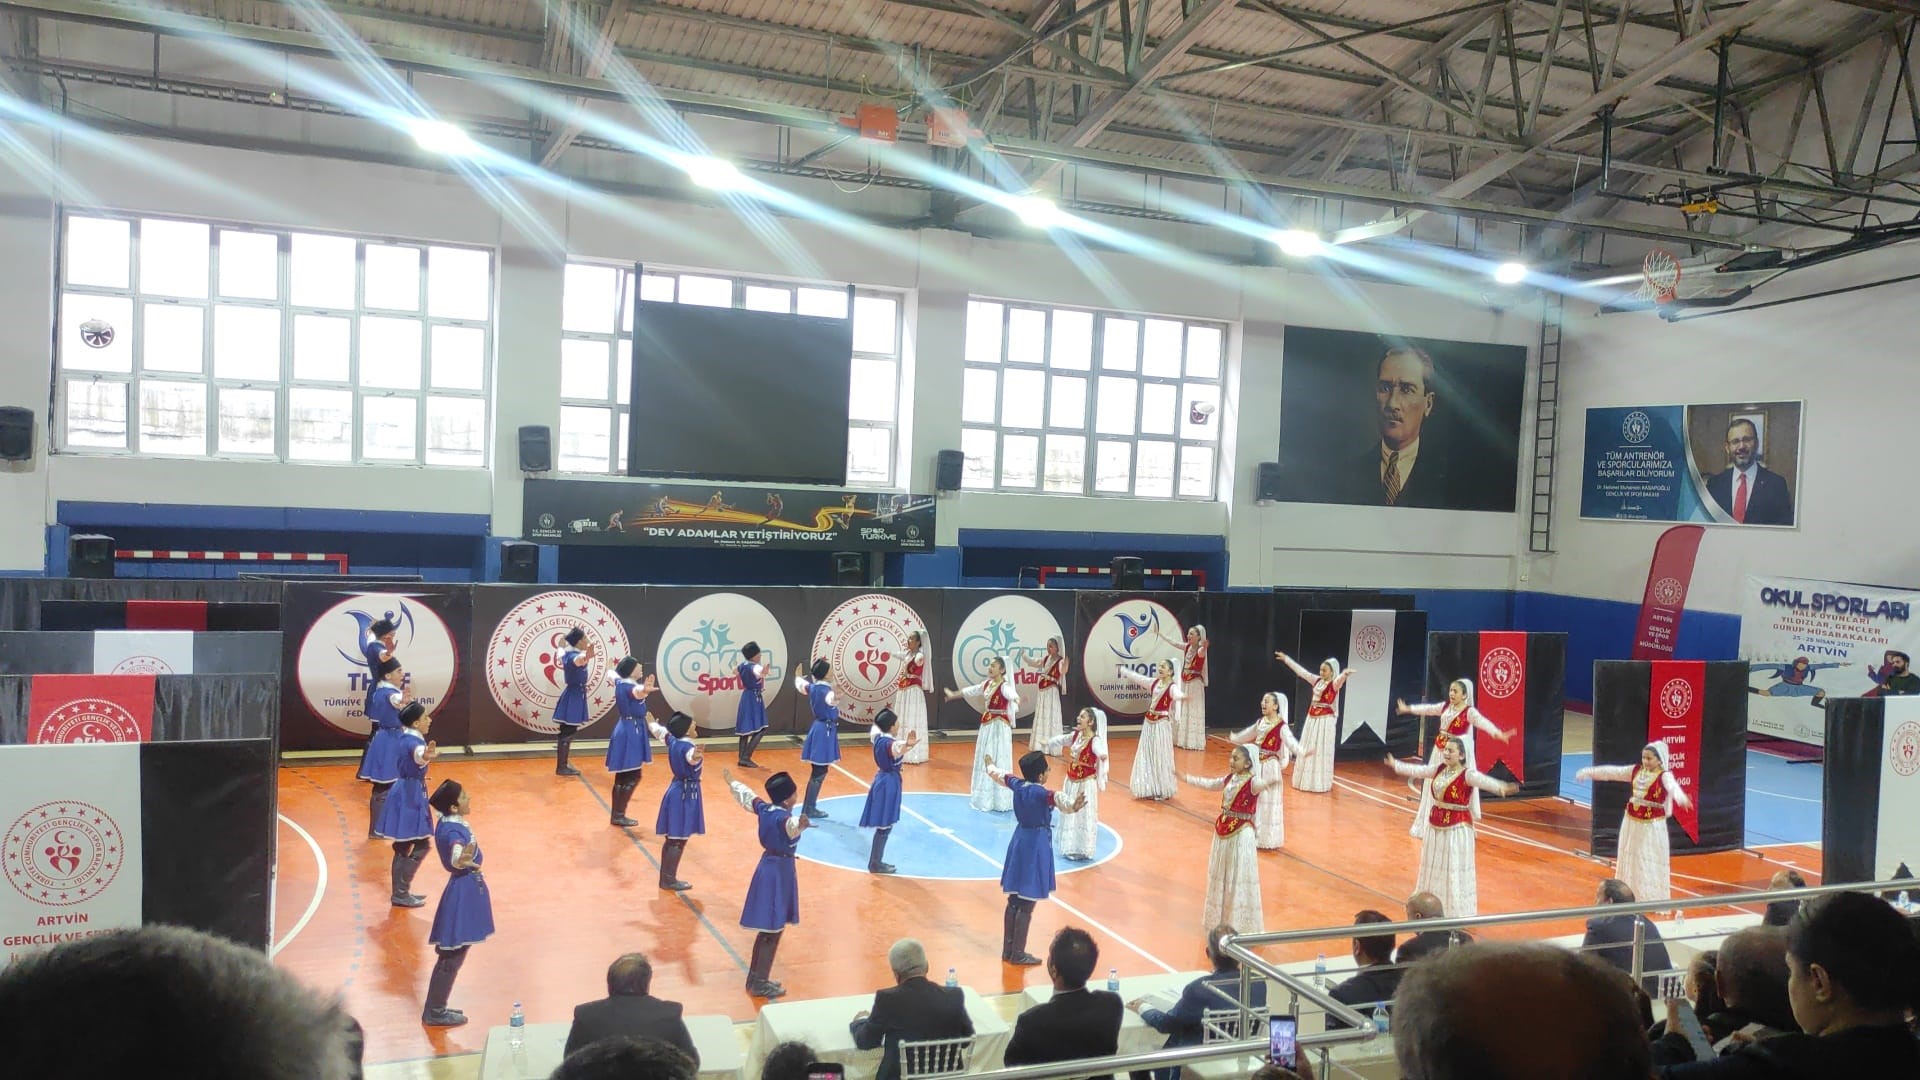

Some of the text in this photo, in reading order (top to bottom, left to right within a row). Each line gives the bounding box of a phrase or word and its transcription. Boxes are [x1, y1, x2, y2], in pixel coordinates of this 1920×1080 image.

[1606, 451, 1665, 460] TÜM ANTRENÖR
[1597, 461, 1672, 469] VE SPORCULARIMIZA
[1597, 469, 1675, 478] BAŞARILAR DİLİYORUM
[677, 529, 738, 539] ADAMLAR
[1760, 587, 1910, 622] OKUL SPORLARI
[1792, 609, 1870, 625] HALK OYUNLARI
[1835, 623, 1881, 635] GENÇLER
[1797, 643, 1848, 658] ARTVİN
[348, 672, 411, 692] THF
[324, 697, 361, 707] TÜRKİYE
[1114, 692, 1153, 700] FEDERASYON
[1668, 752, 1685, 762] NÇLİK
[52, 819, 85, 831] GENÇLİK
[37, 912, 88, 926] ARTVİN
[3, 931, 62, 947] GENÇLİK
[64, 930, 83, 942] VE
